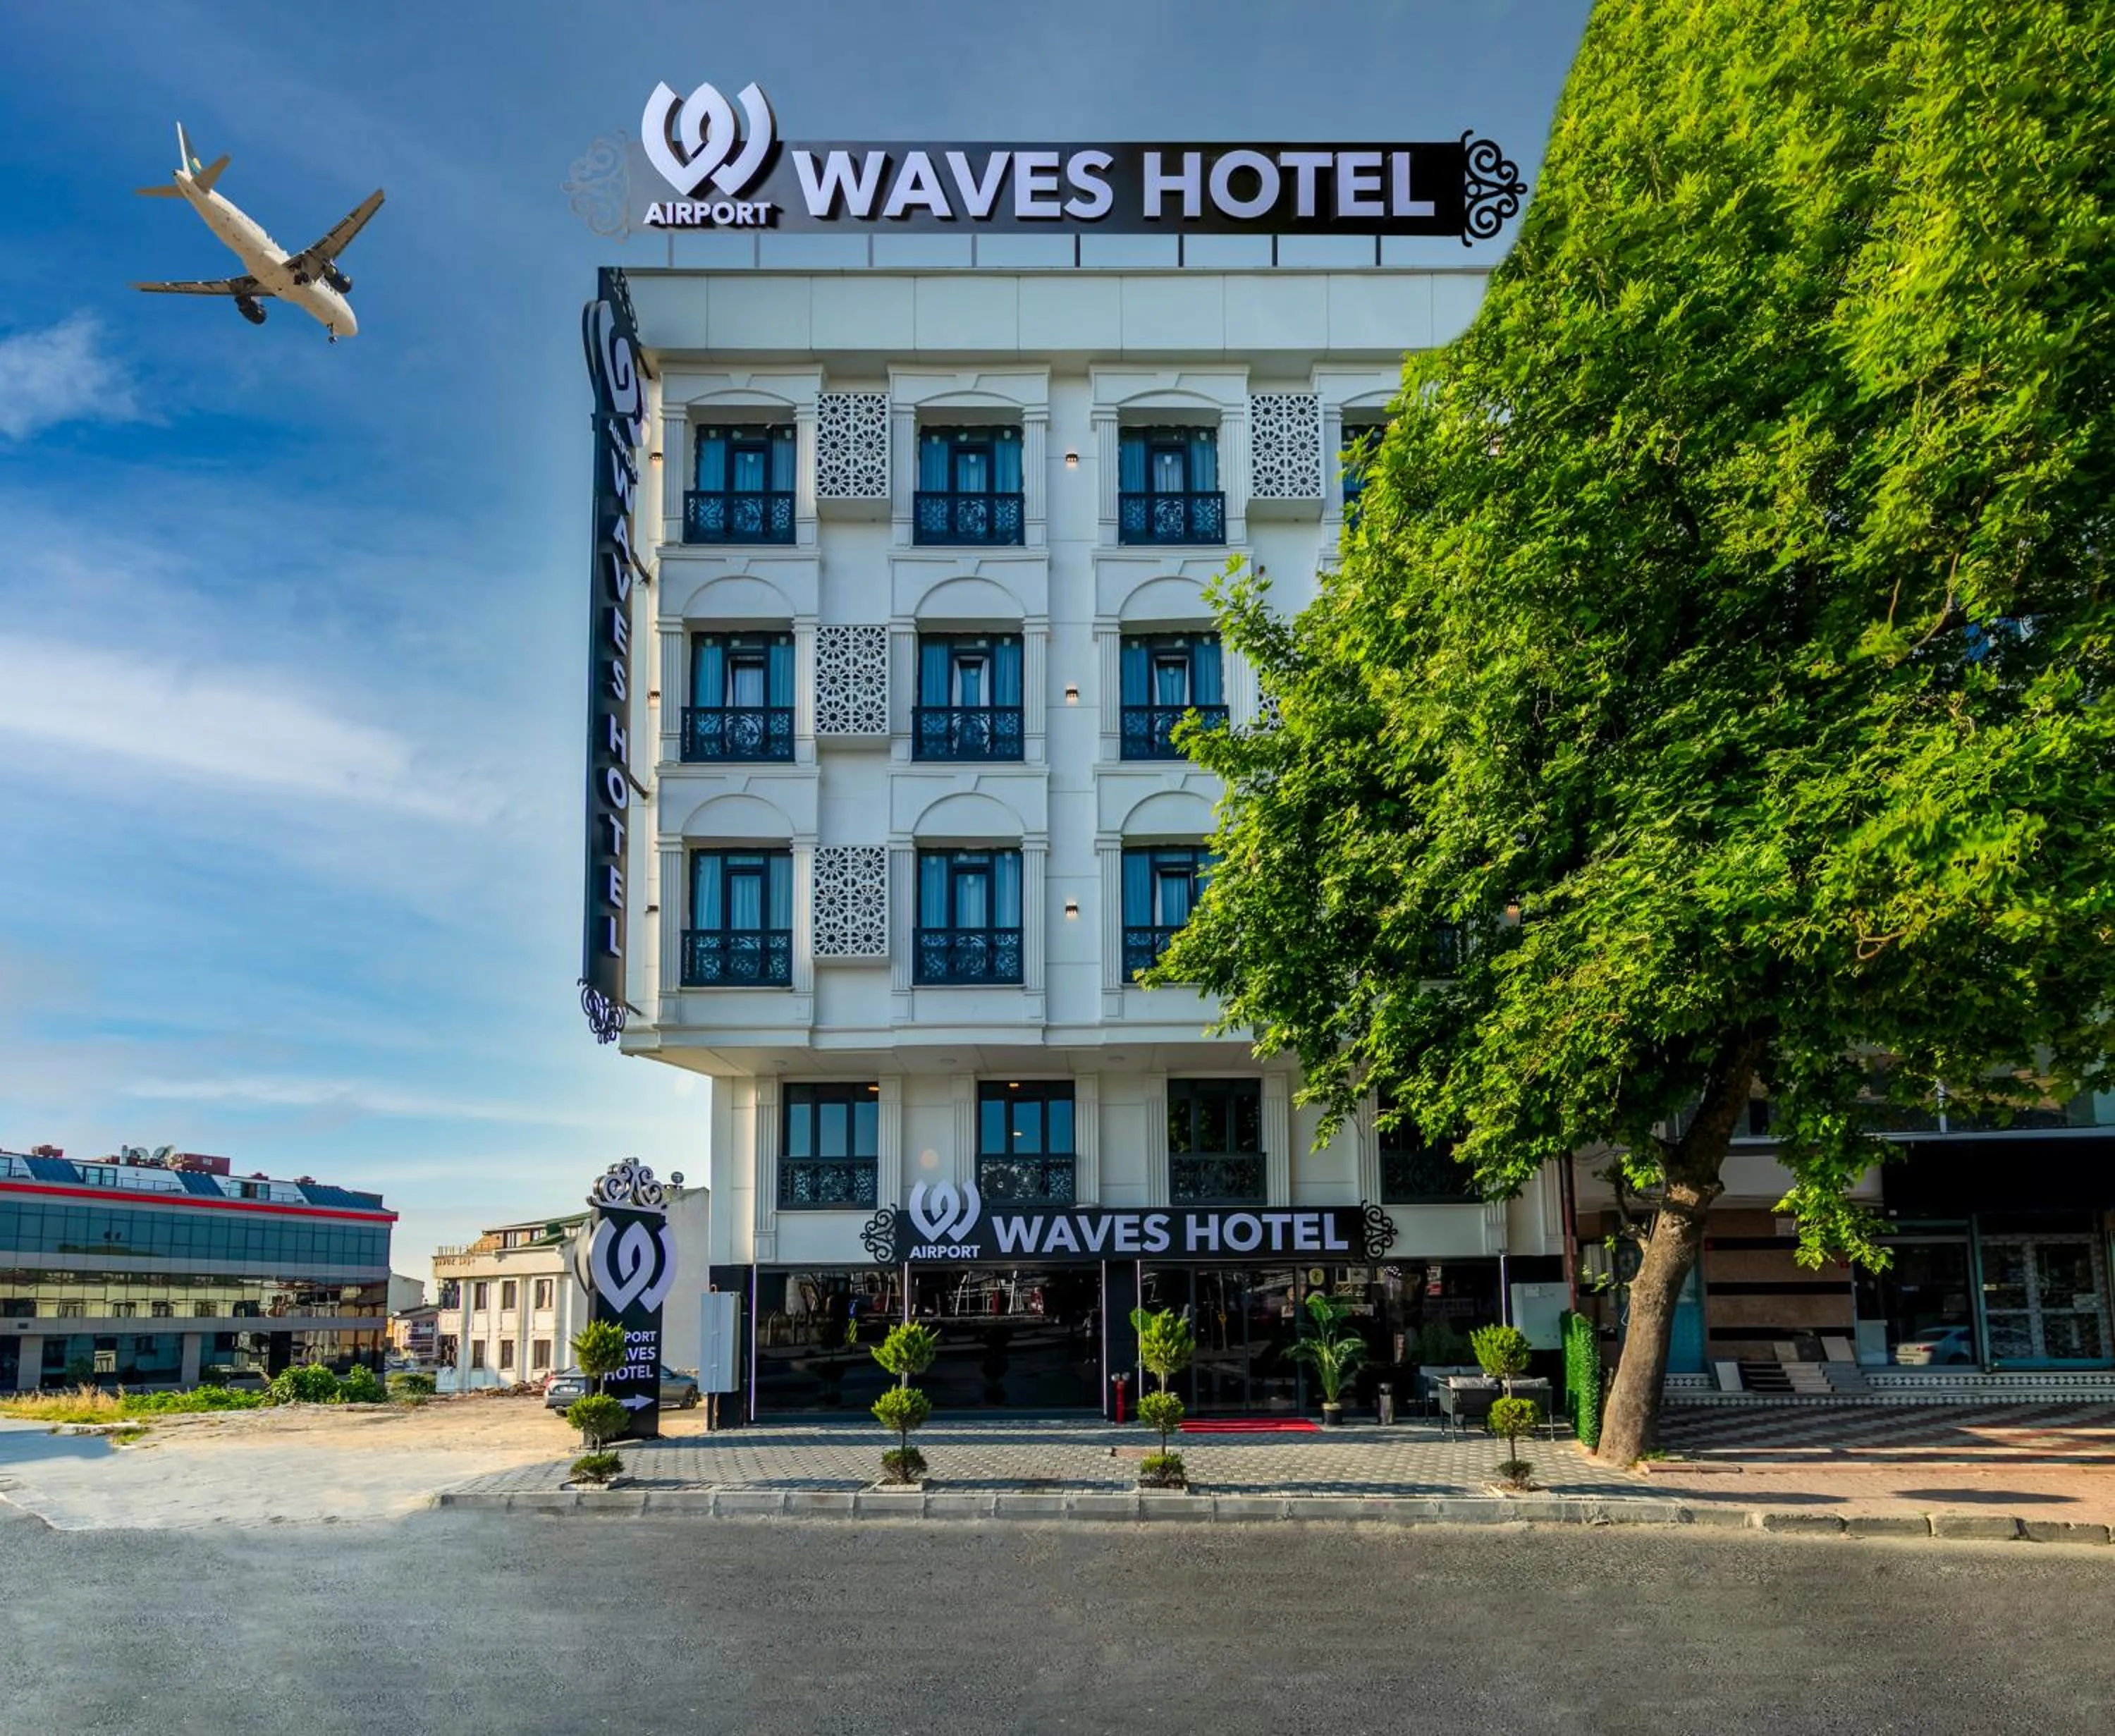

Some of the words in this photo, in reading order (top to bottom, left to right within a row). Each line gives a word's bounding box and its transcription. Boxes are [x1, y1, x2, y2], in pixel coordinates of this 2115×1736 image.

[792, 150, 1115, 219] WAVES
[1143, 149, 1435, 218] HOTEL
[643, 202, 771, 225] AIRPORT
[611, 448, 634, 701] WAVES
[607, 714, 627, 958] HOTEL
[992, 1213, 1172, 1253] WAVES
[1186, 1212, 1348, 1252] HOTEL
[909, 1245, 981, 1259] AIRPORT
[624, 1331, 657, 1343] PORT
[625, 1346, 656, 1362] VES
